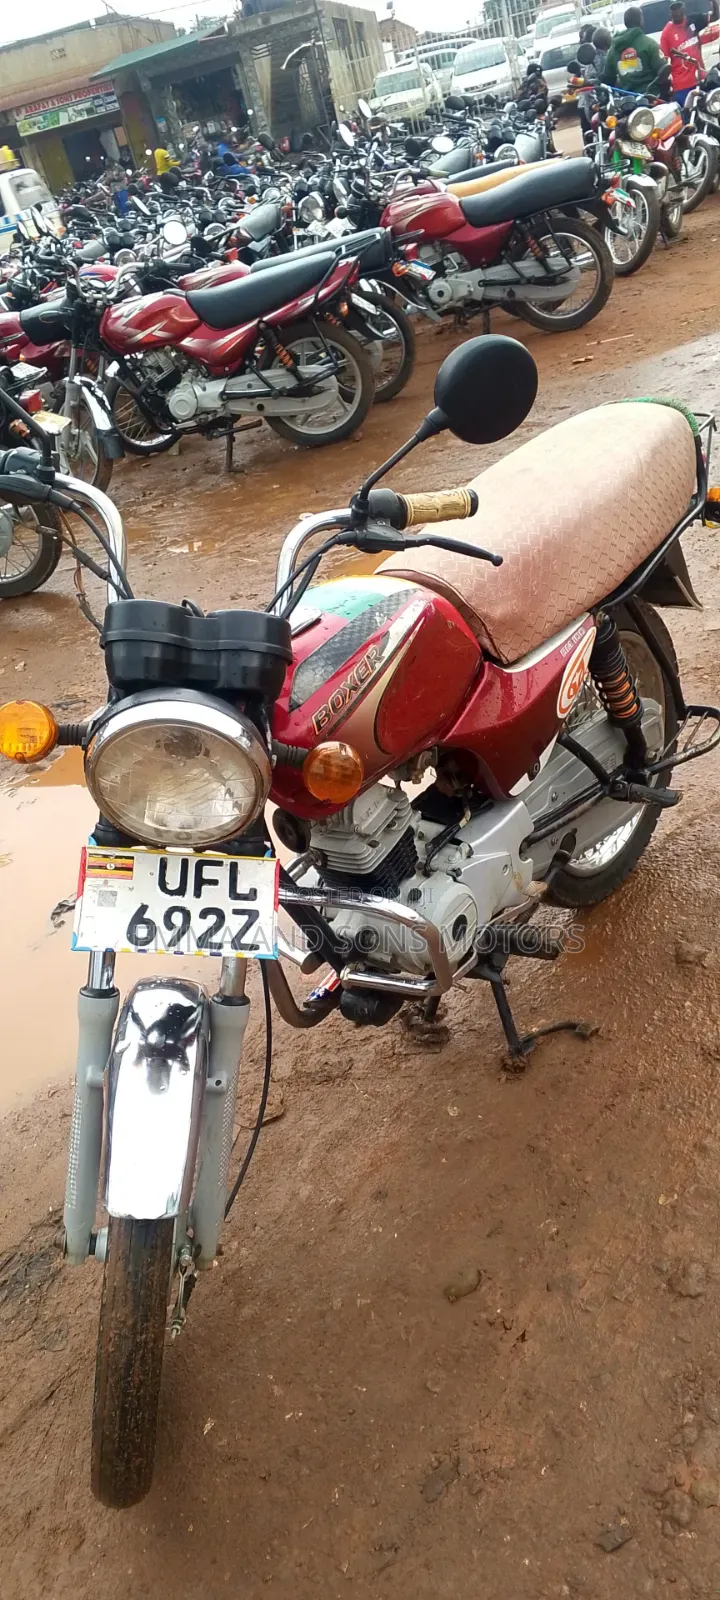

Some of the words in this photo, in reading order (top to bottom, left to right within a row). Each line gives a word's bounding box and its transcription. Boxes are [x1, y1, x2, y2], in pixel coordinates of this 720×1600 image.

[311, 643, 385, 735] BOXER
[157, 857, 258, 901] UFL
[126, 902, 260, 951] 692Z
